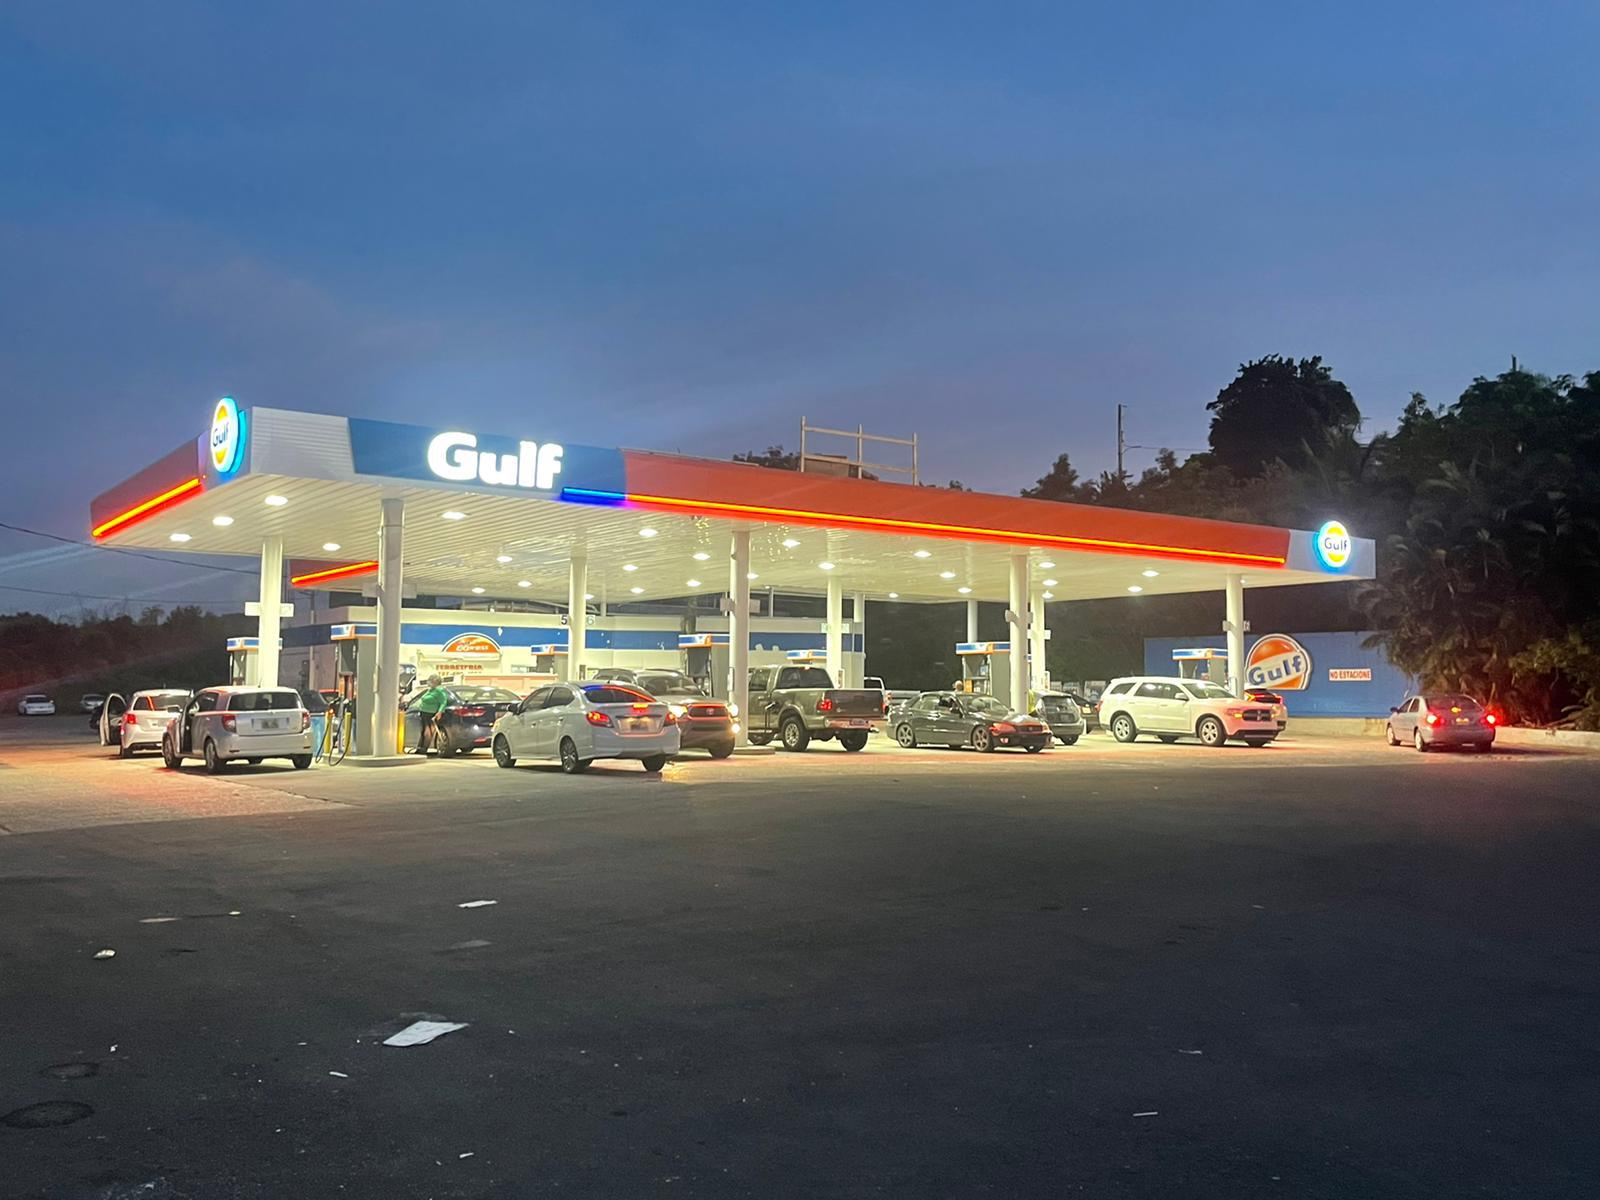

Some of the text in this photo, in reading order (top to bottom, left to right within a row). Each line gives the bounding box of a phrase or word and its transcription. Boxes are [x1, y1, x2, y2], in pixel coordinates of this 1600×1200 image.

[212, 421, 230, 447] Gulf
[426, 430, 564, 490] Gulf
[1324, 537, 1347, 551] Gulf
[560, 614, 568, 625] 5
[586, 615, 595, 625] 6
[1247, 655, 1303, 686] Gulf
[1330, 669, 1371, 680] NO ESTACIONE
